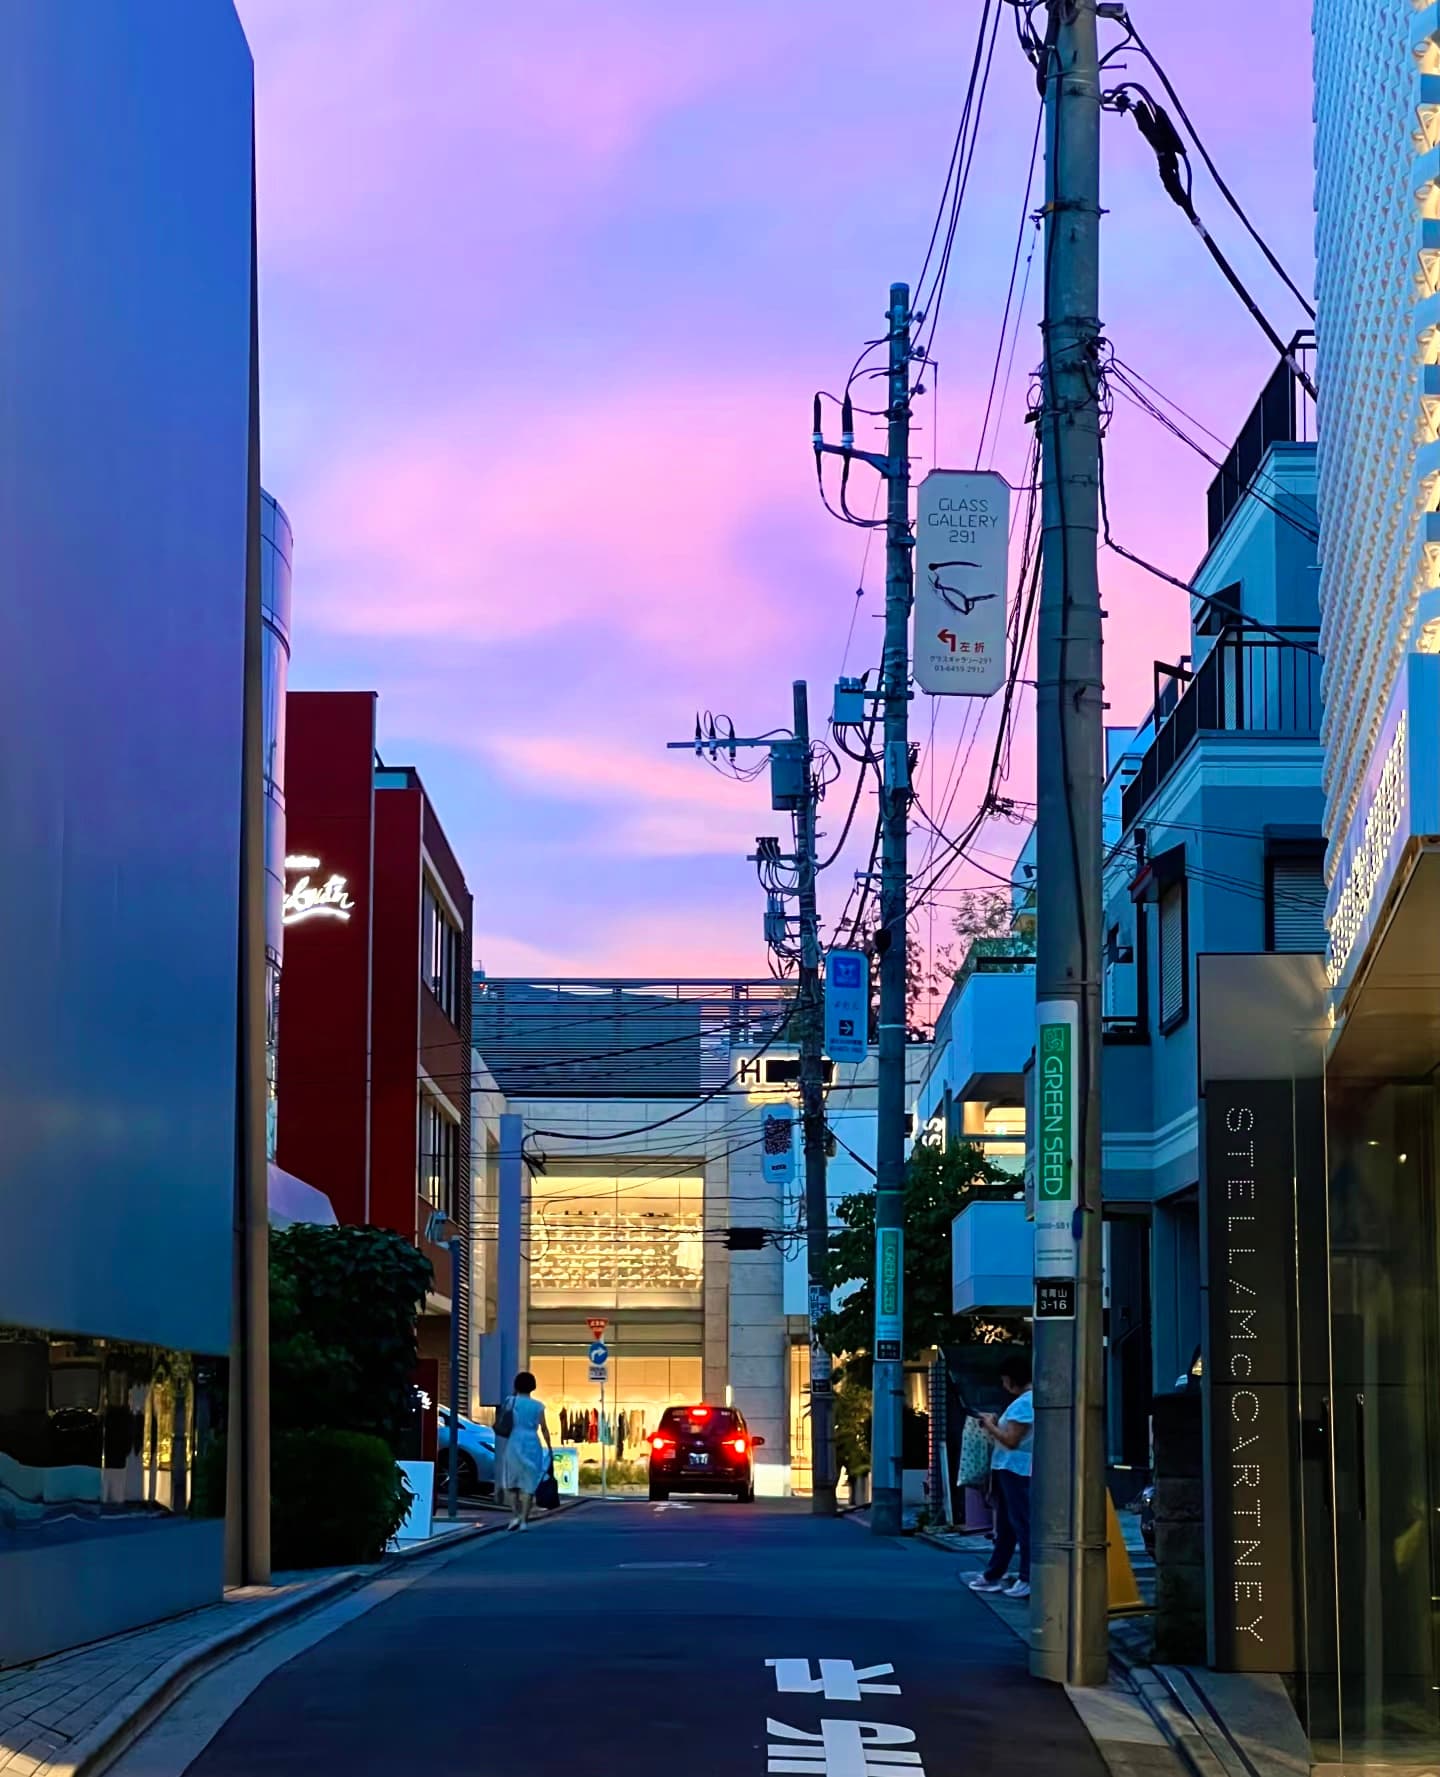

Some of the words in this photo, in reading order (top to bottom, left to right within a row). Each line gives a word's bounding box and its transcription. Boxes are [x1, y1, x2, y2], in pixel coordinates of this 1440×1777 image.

[939, 498, 989, 512] GLASS
[928, 513, 999, 528] GALLERY
[949, 529, 976, 543] 291
[959, 641, 985, 653] 左折
[1044, 1055, 1064, 1132] GREEN
[1044, 1136, 1064, 1196] SEED
[1040, 1299, 1068, 1311] 3-16
